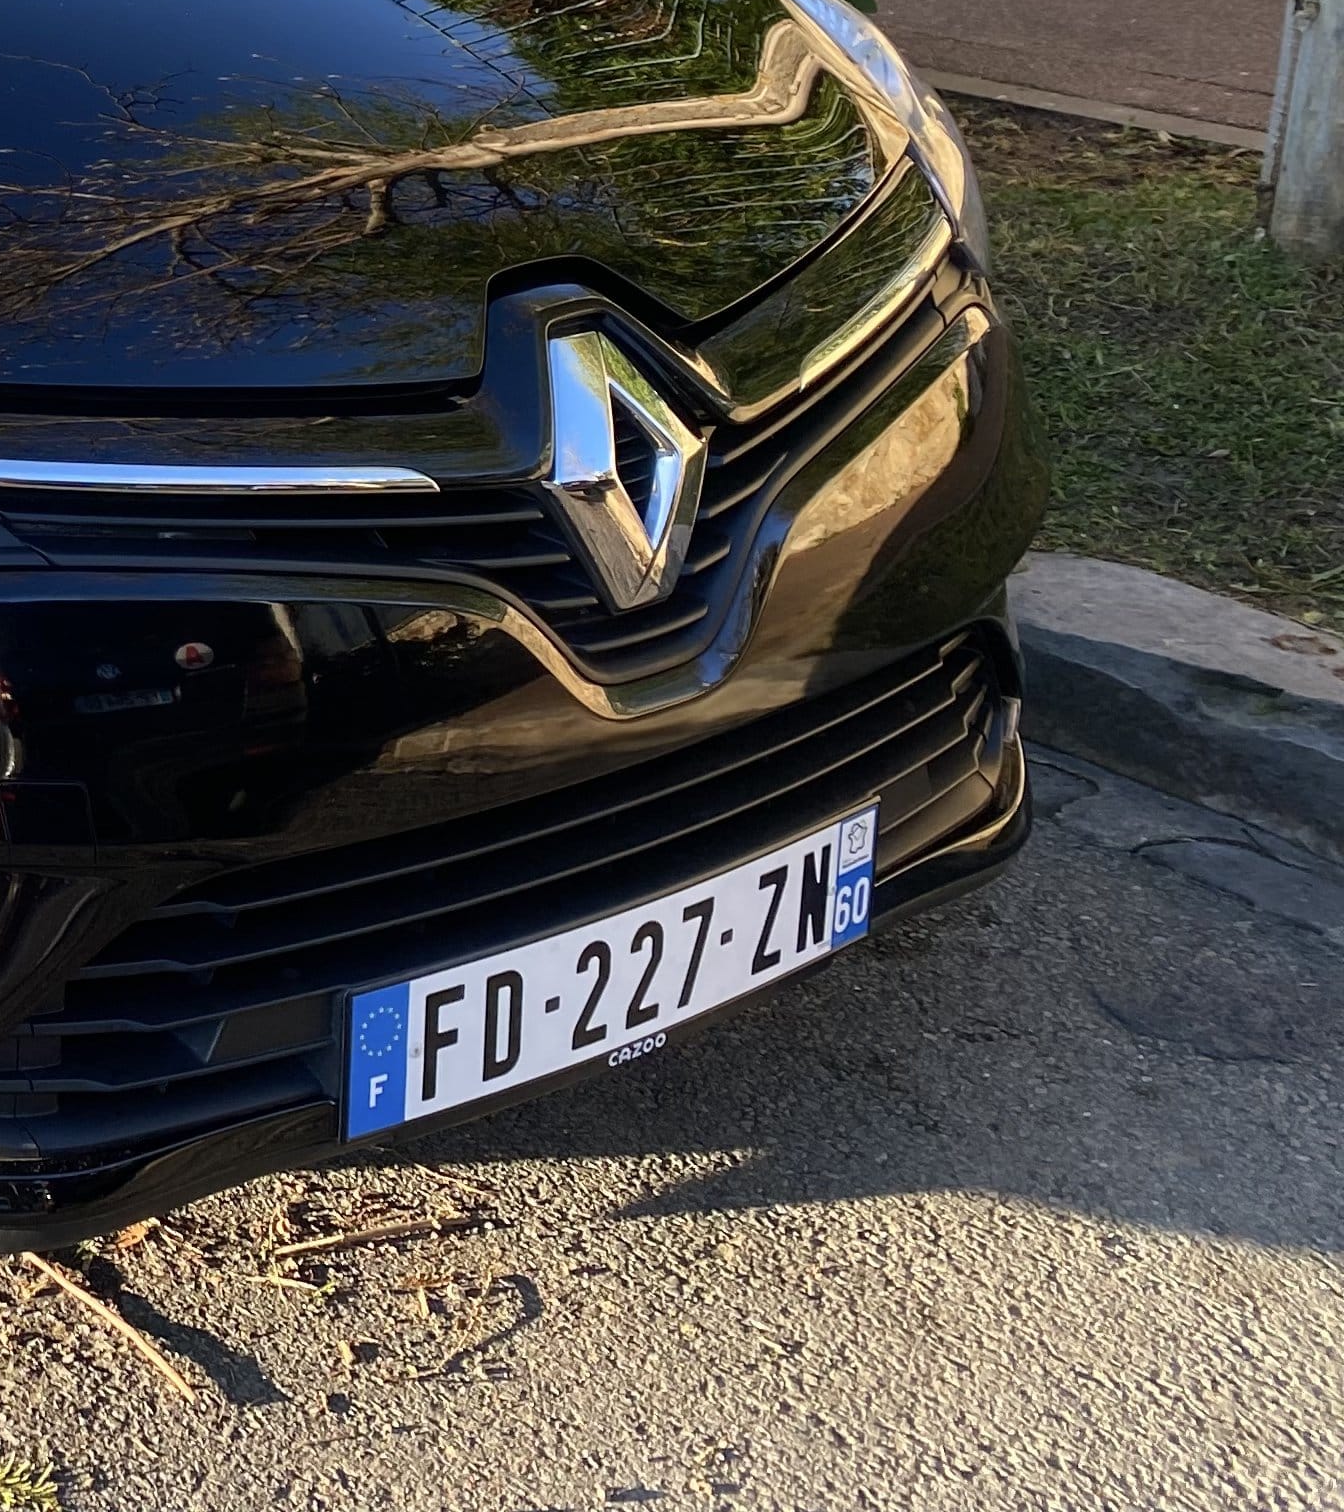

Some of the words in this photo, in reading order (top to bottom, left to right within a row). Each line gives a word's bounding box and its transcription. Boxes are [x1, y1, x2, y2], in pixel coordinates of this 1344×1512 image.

[834, 876, 871, 934] 60
[422, 842, 832, 1101] FD-227-ZN
[608, 1032, 667, 1067] CAZOO
[368, 1073, 388, 1108] F
